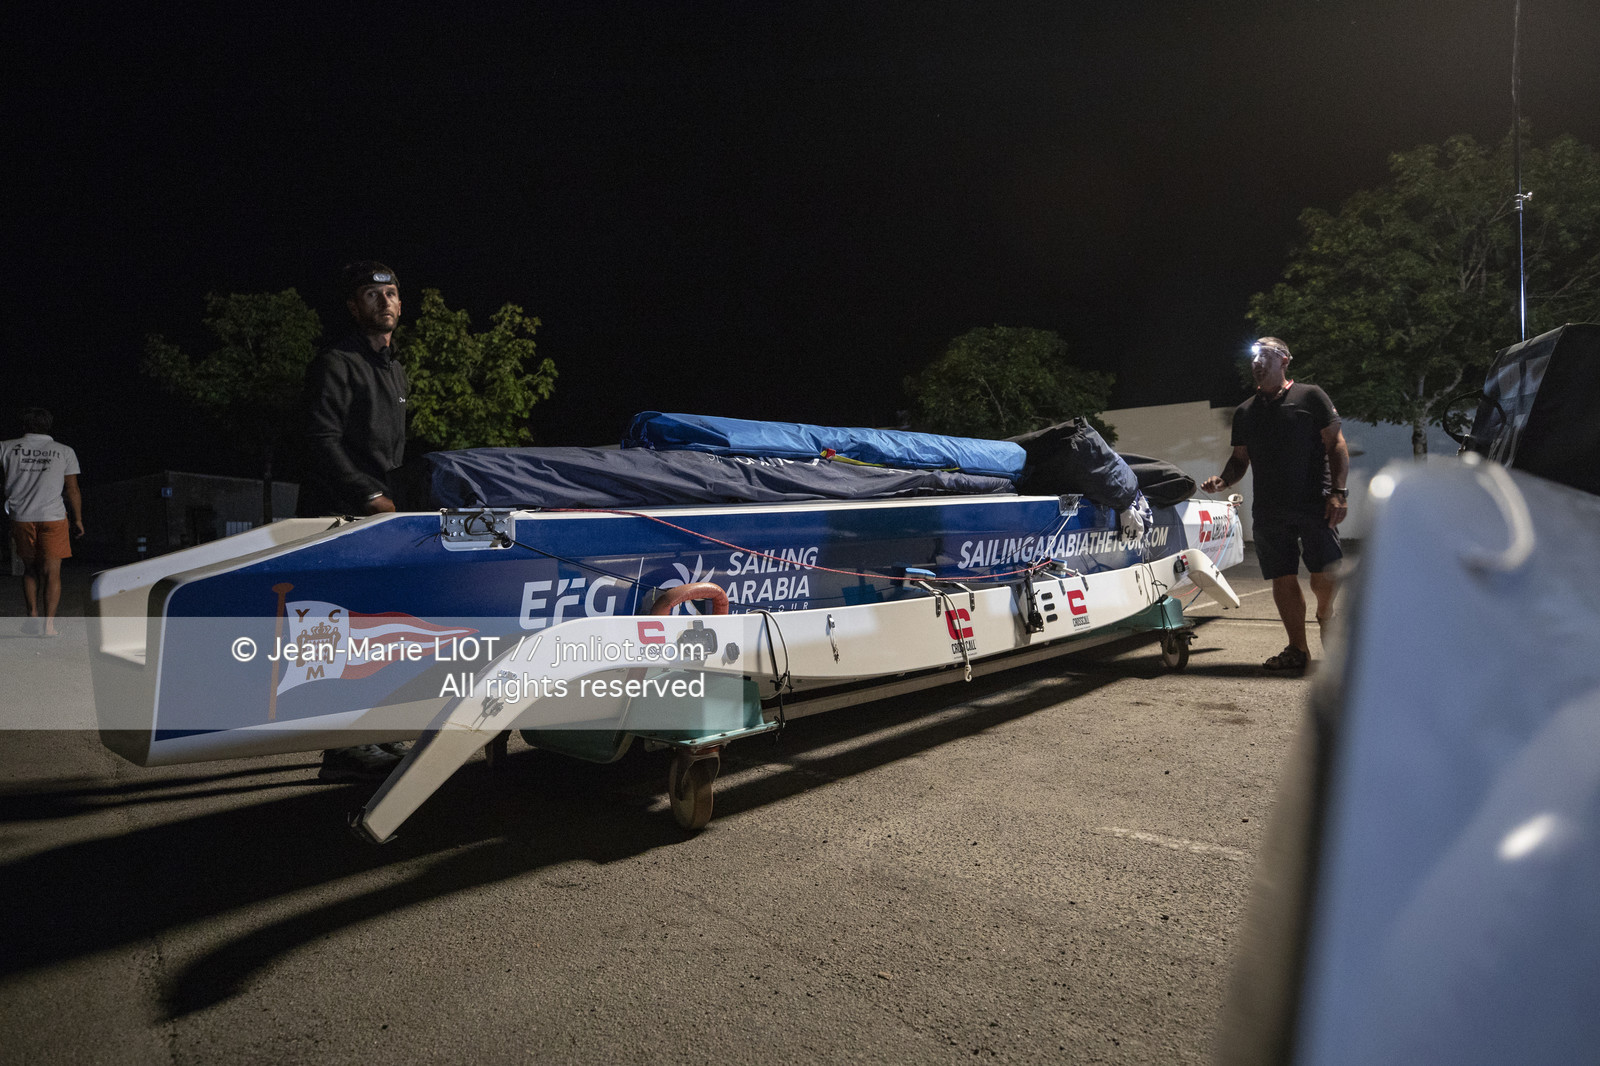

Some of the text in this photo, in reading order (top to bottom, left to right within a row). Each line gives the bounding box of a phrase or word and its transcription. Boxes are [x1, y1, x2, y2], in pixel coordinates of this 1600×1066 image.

[727, 547, 819, 576] SAILING
[519, 575, 617, 630] EFG
[726, 575, 810, 605] ARABIA
[951, 640, 977, 654] CROSCALL
